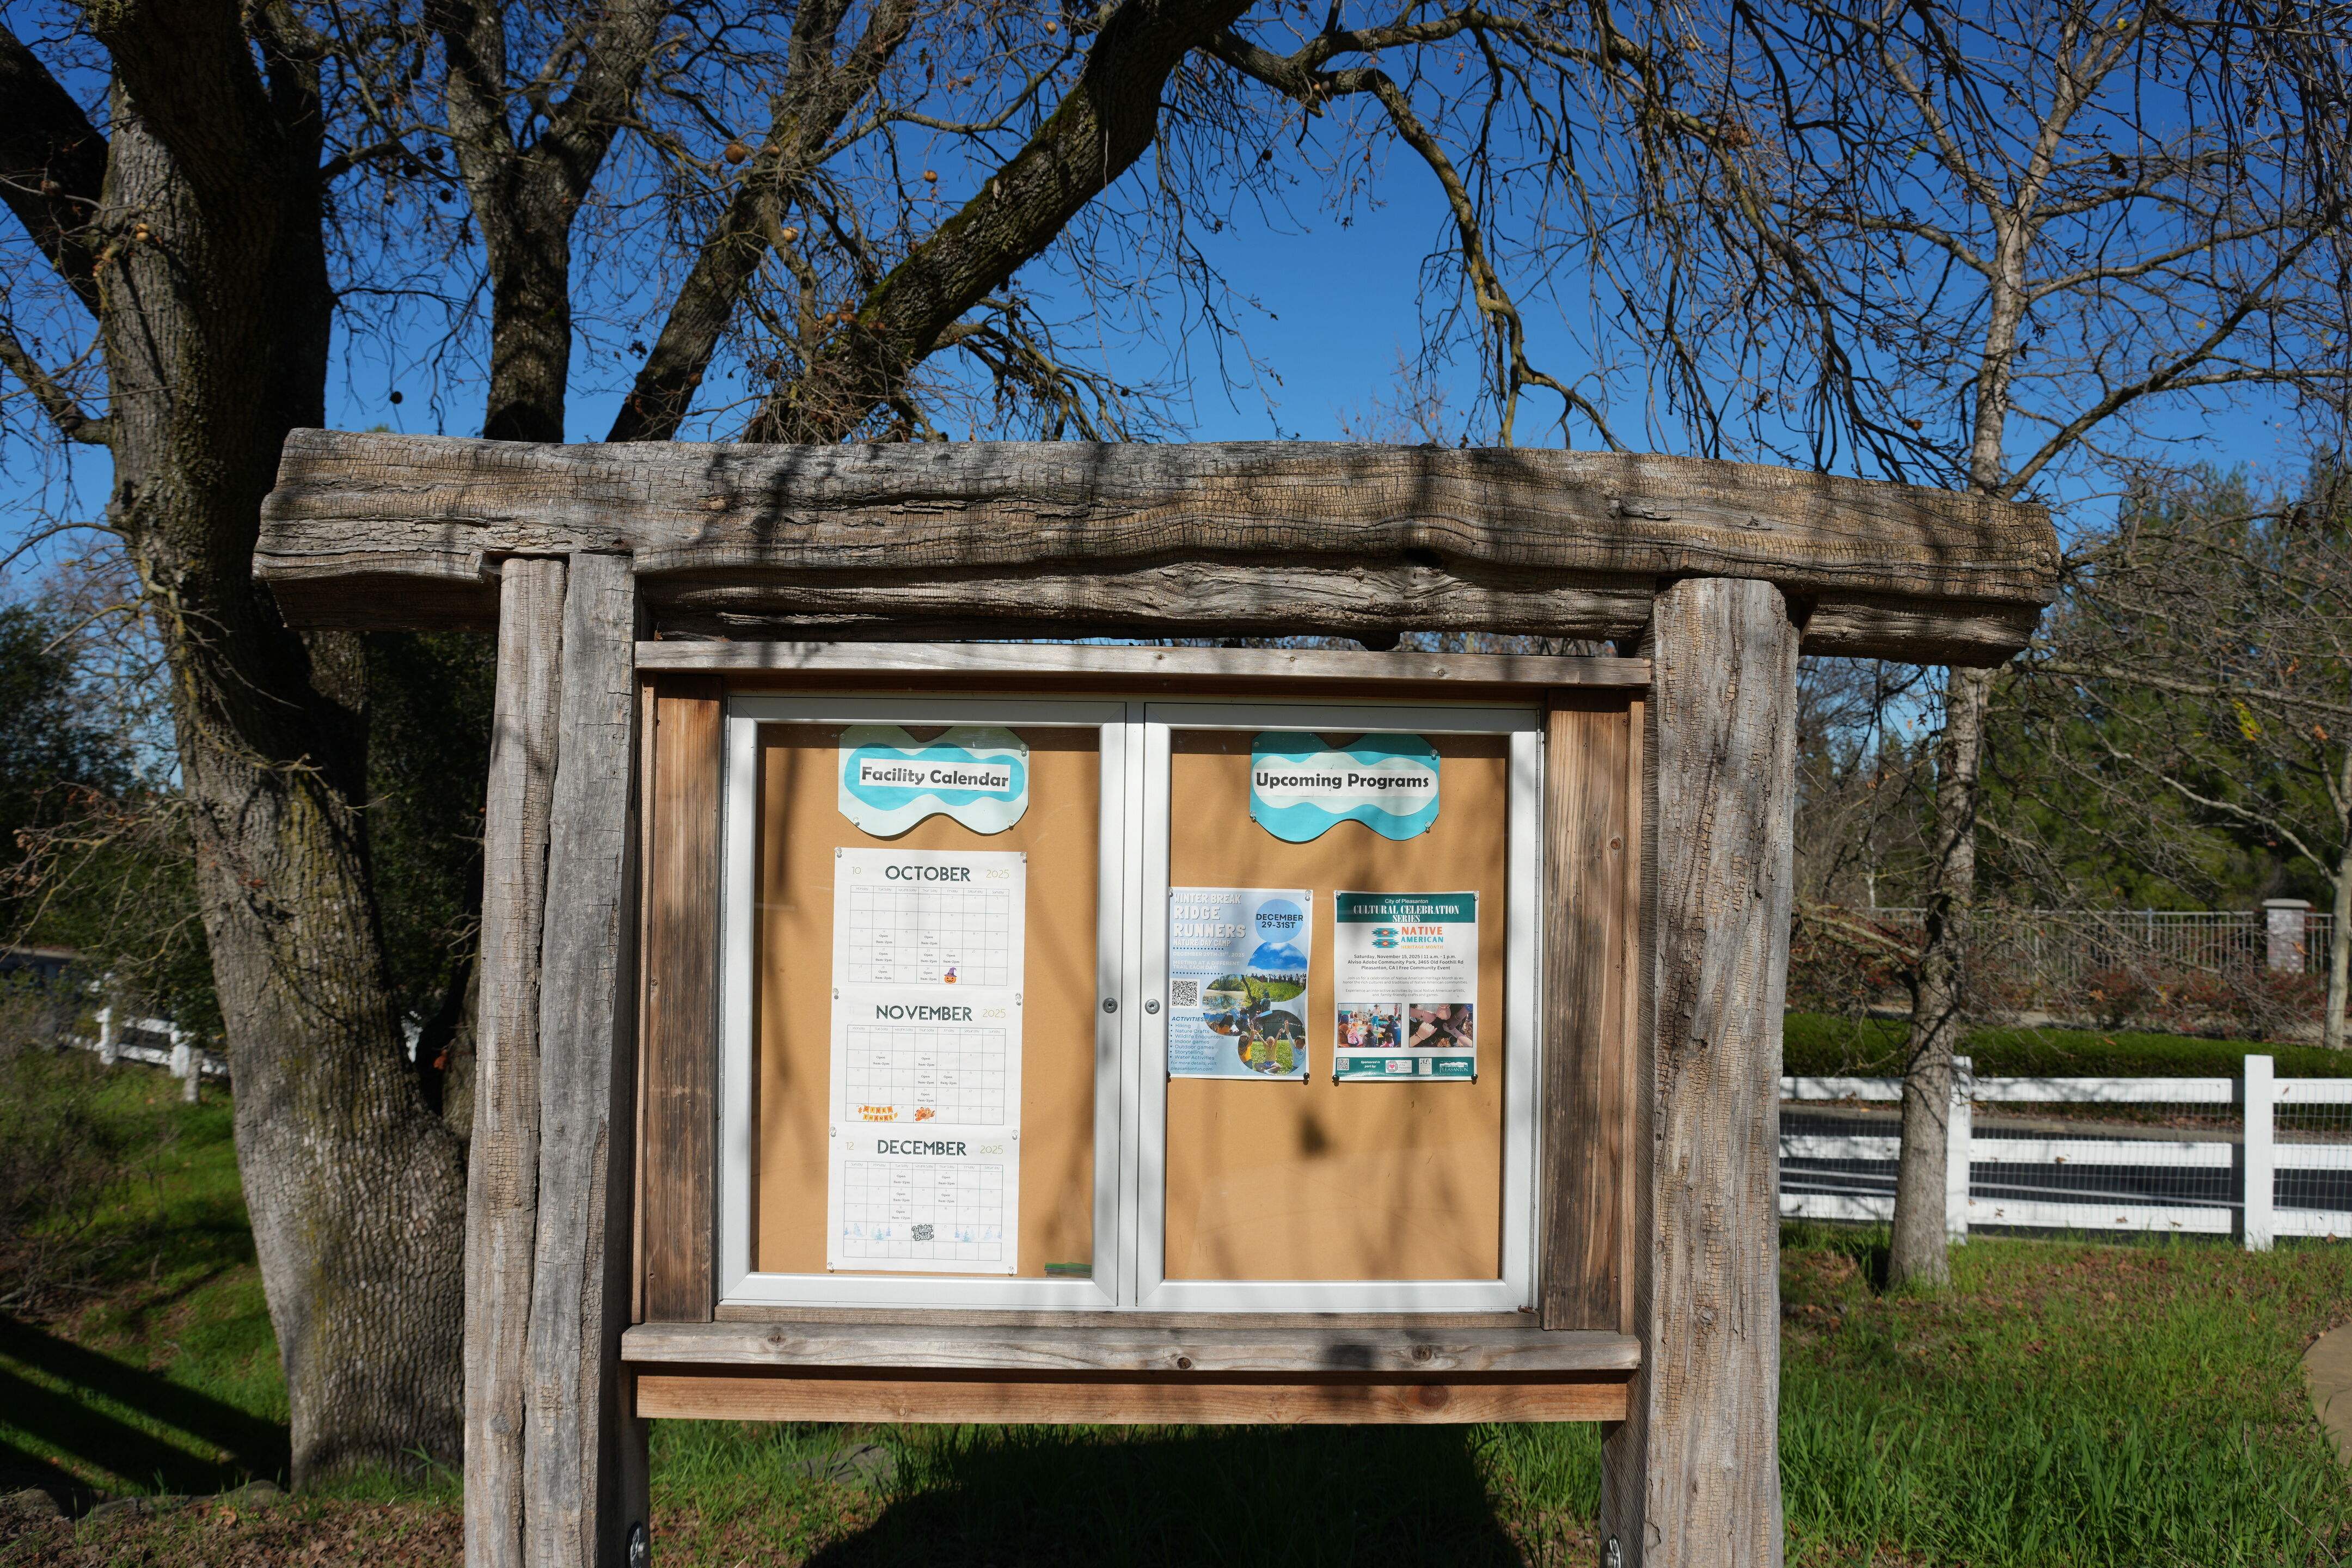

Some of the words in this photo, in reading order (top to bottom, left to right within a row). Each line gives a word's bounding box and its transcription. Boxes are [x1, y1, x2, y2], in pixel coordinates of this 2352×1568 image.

[862, 767, 924, 785] Facility
[930, 770, 1008, 787] Calendar
[1257, 773, 1342, 789] Upcoming
[1347, 774, 1429, 789] Programs
[885, 866, 971, 881] OCTOBER
[986, 869, 1009, 879] 2025
[1174, 893, 1209, 904] WINTER
[1210, 893, 1241, 904] BREAK
[1174, 905, 1221, 920] RIDGE
[1353, 905, 1399, 914] CULTURAL
[1400, 905, 1459, 915] CELEBRATION
[1174, 923, 1246, 938] RUNNERS
[1401, 927, 1443, 935] NATIVE
[876, 1005, 972, 1021] NOVEMBER
[982, 1009, 1006, 1018] 2025
[846, 1142, 854, 1150] 12
[877, 1140, 967, 1156] DECEMBER
[980, 1145, 1003, 1155] 2025
[912, 1224, 933, 1233] Winter
[915, 1233, 932, 1241] Break
